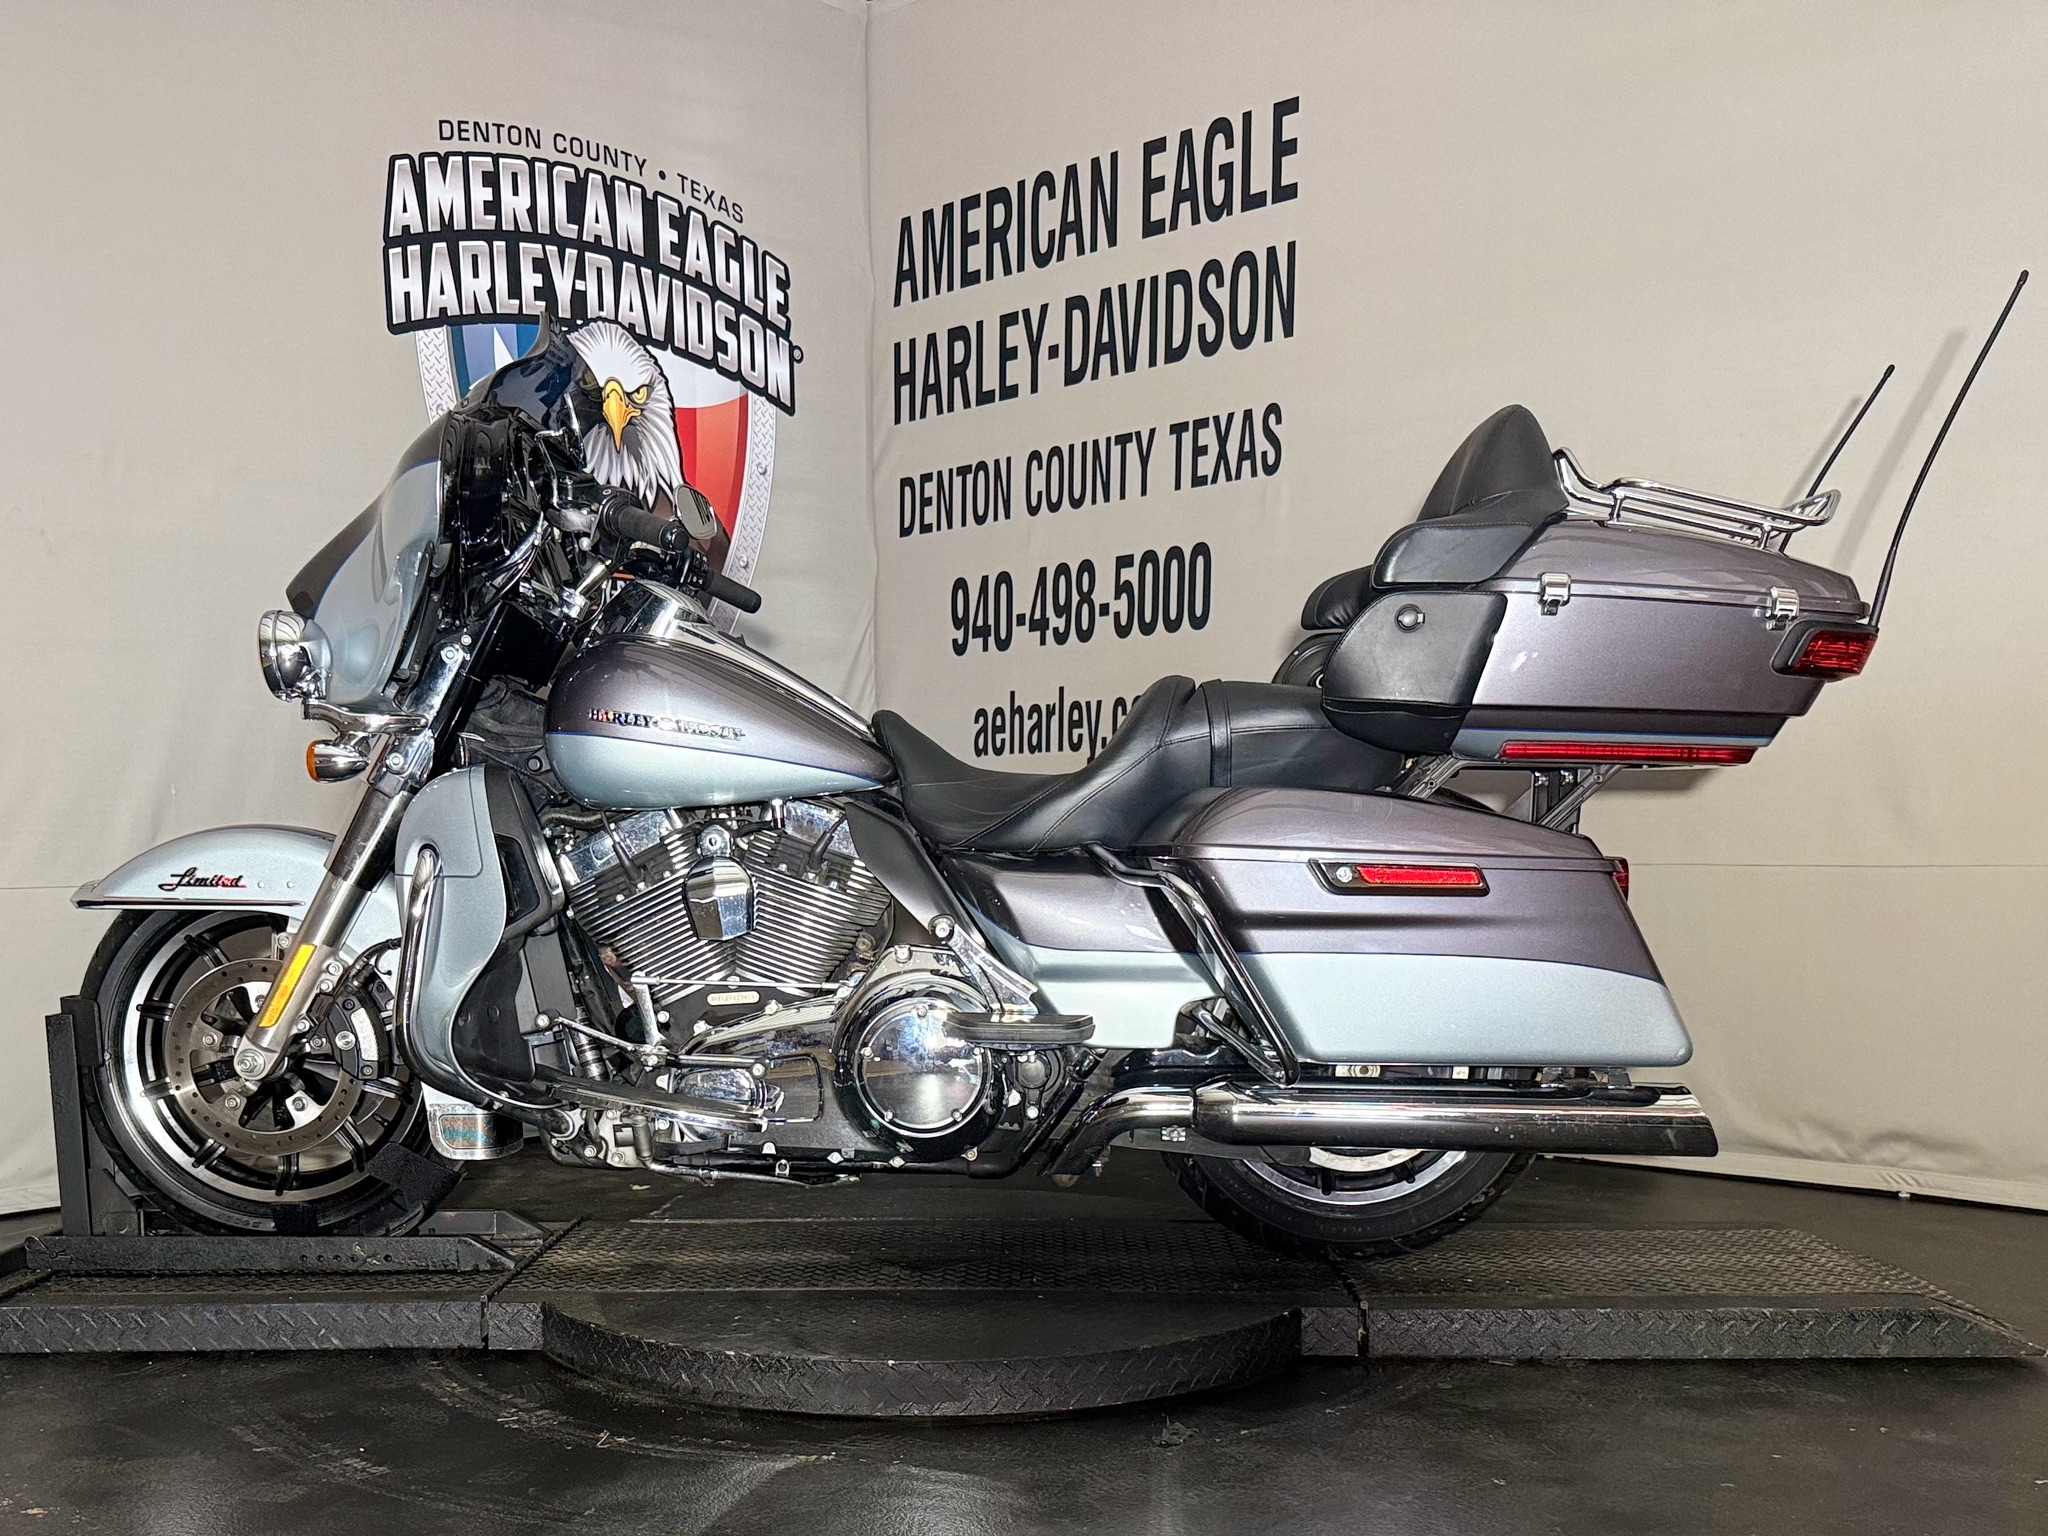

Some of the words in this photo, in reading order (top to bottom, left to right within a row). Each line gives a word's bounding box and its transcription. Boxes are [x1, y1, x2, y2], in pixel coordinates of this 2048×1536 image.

[438, 119, 542, 150] DENTON
[552, 132, 648, 177] COUNTY
[676, 171, 745, 224] TEXAS
[893, 149, 1119, 308] AMERICAN
[1141, 95, 1300, 240] EAGLE
[387, 154, 646, 259] AMERICAN
[655, 193, 791, 332] EAGLE
[893, 239, 1297, 426] HARLEY-DAVIDSON
[899, 455, 1012, 538] DENTON
[1024, 426, 1157, 517] COUNTY
[1168, 402, 1283, 491] TEXAS
[950, 541, 1212, 657] 940-498-5000
[973, 685, 1142, 765] aeharley.c
[158, 866, 247, 892] Limited
